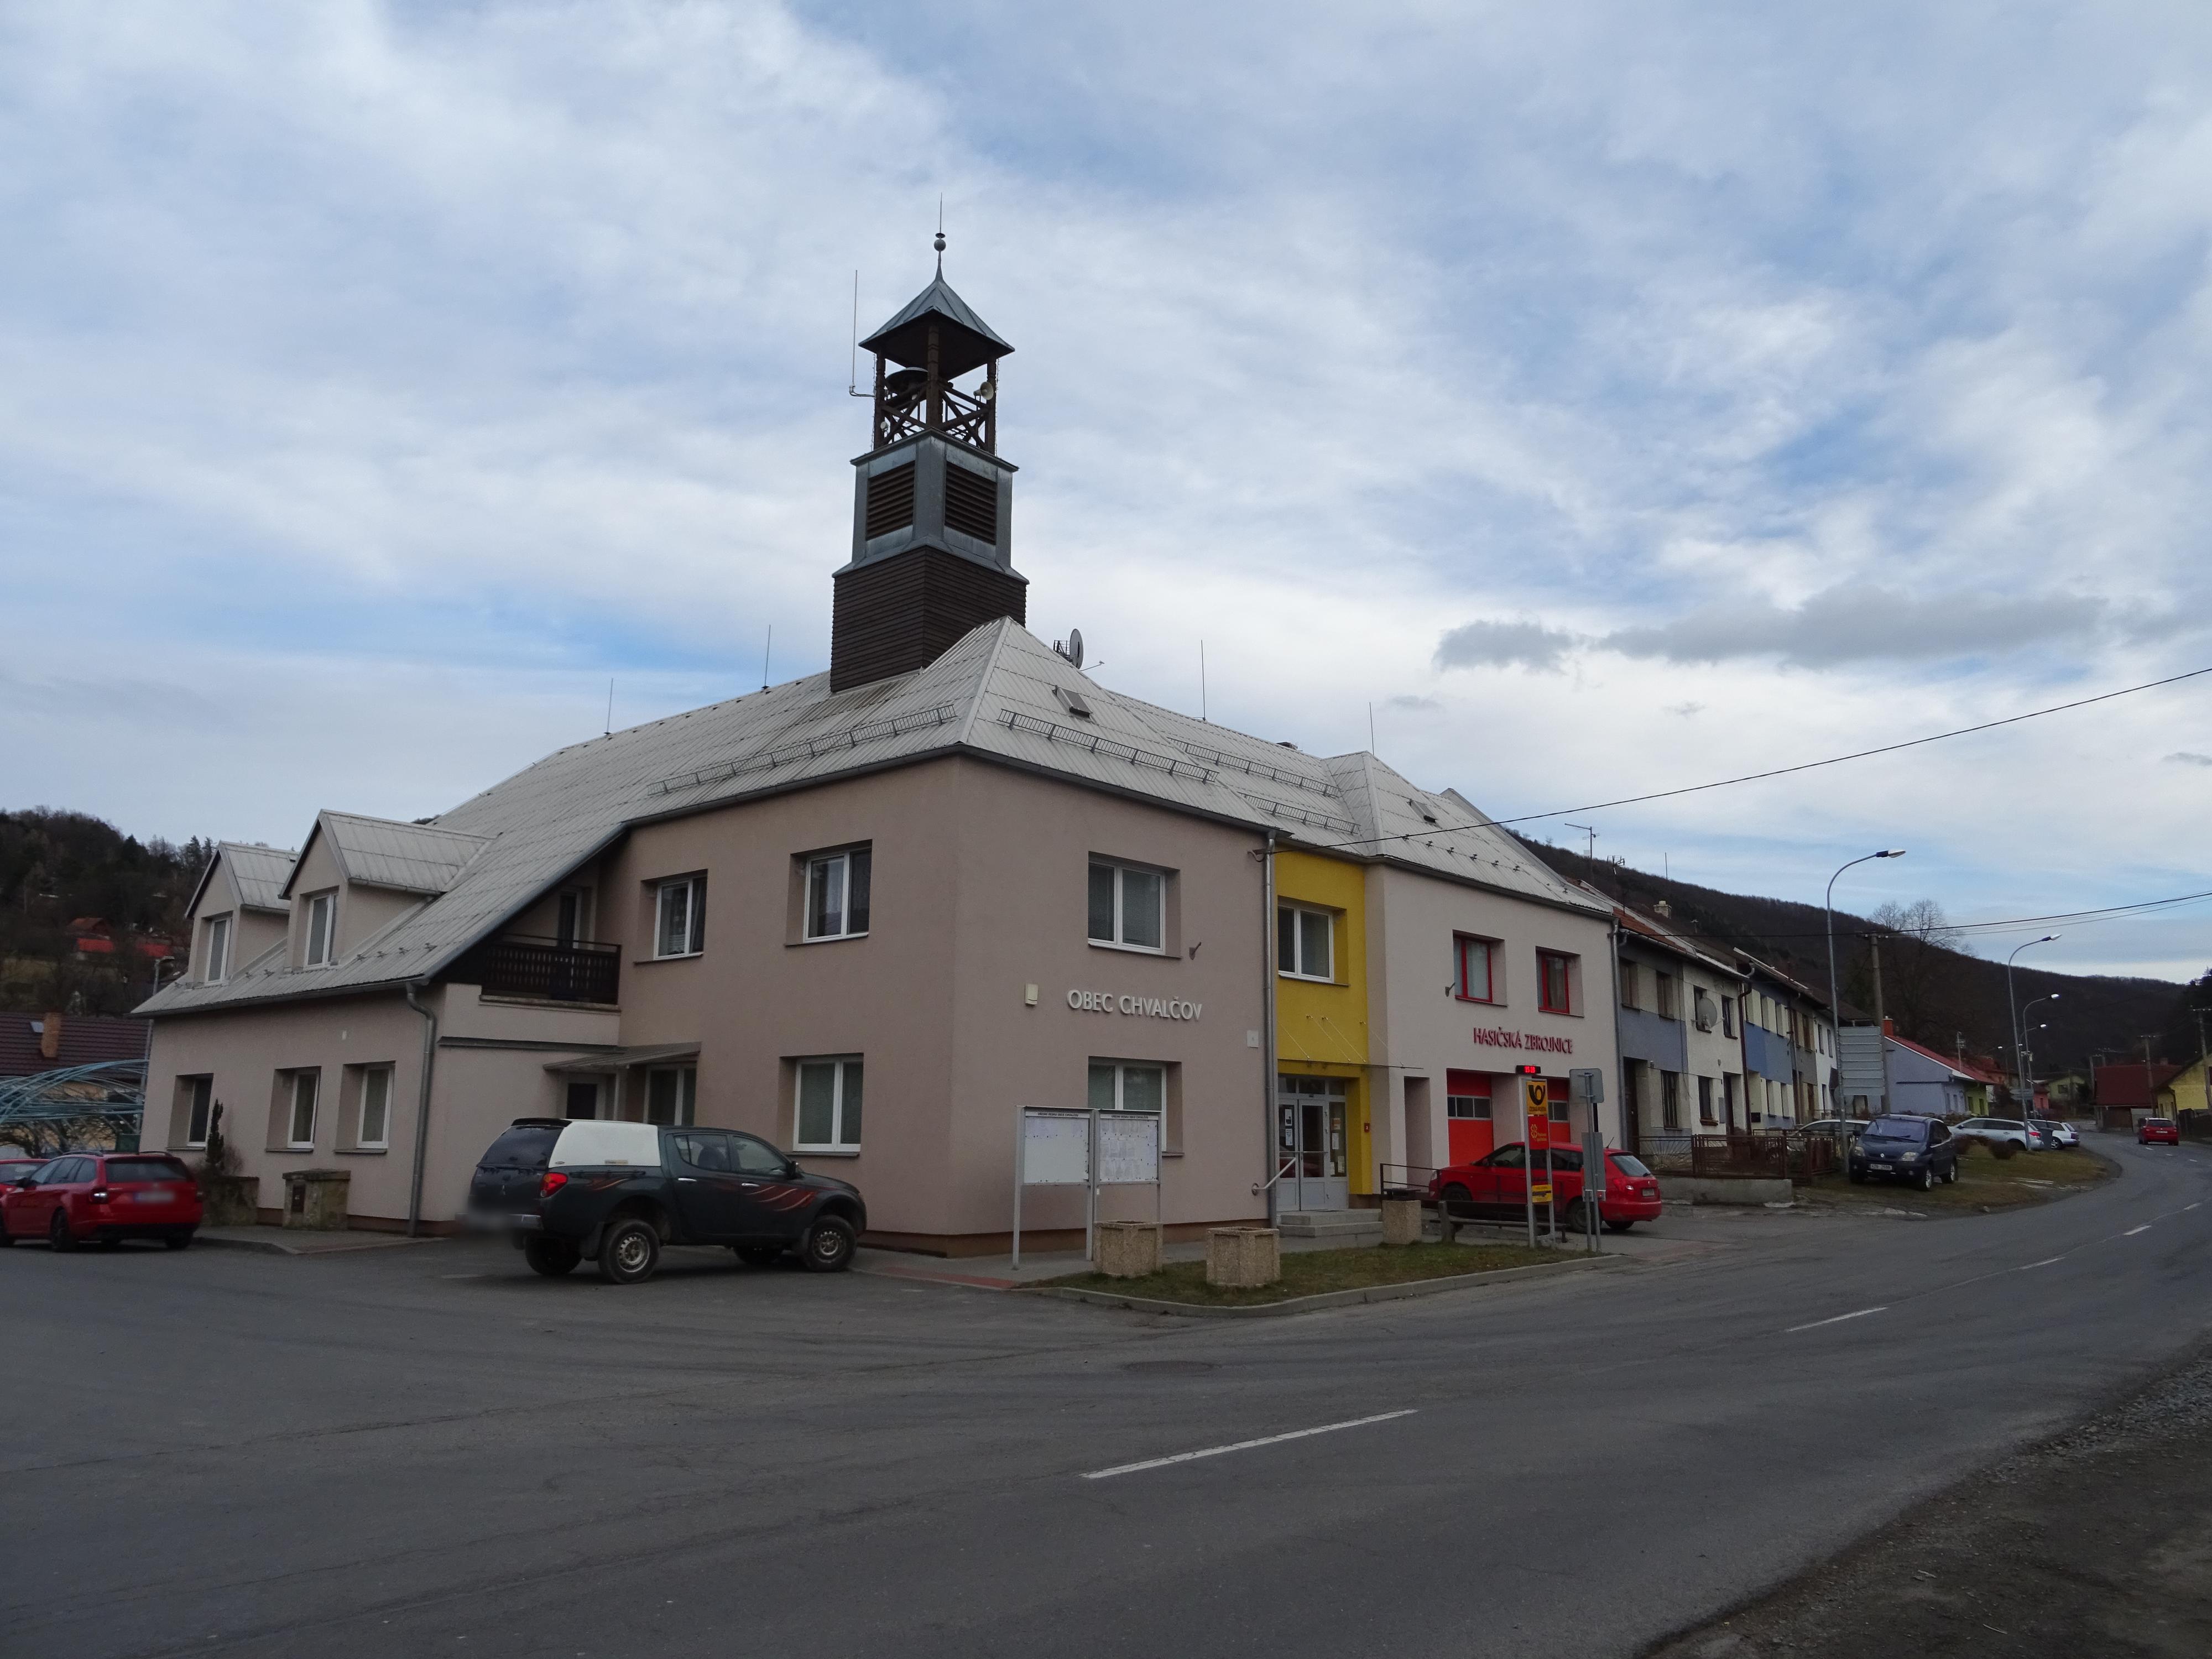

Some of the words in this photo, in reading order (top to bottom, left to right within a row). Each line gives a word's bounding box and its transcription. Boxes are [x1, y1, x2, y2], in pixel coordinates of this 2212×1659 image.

[1067, 989, 1113, 1013] OBEC
[1118, 995, 1203, 1021] CHVALČOV
[1473, 1026, 1522, 1048] HASIČSKÁ
[1524, 1034, 1573, 1053] ZBROJNICE
